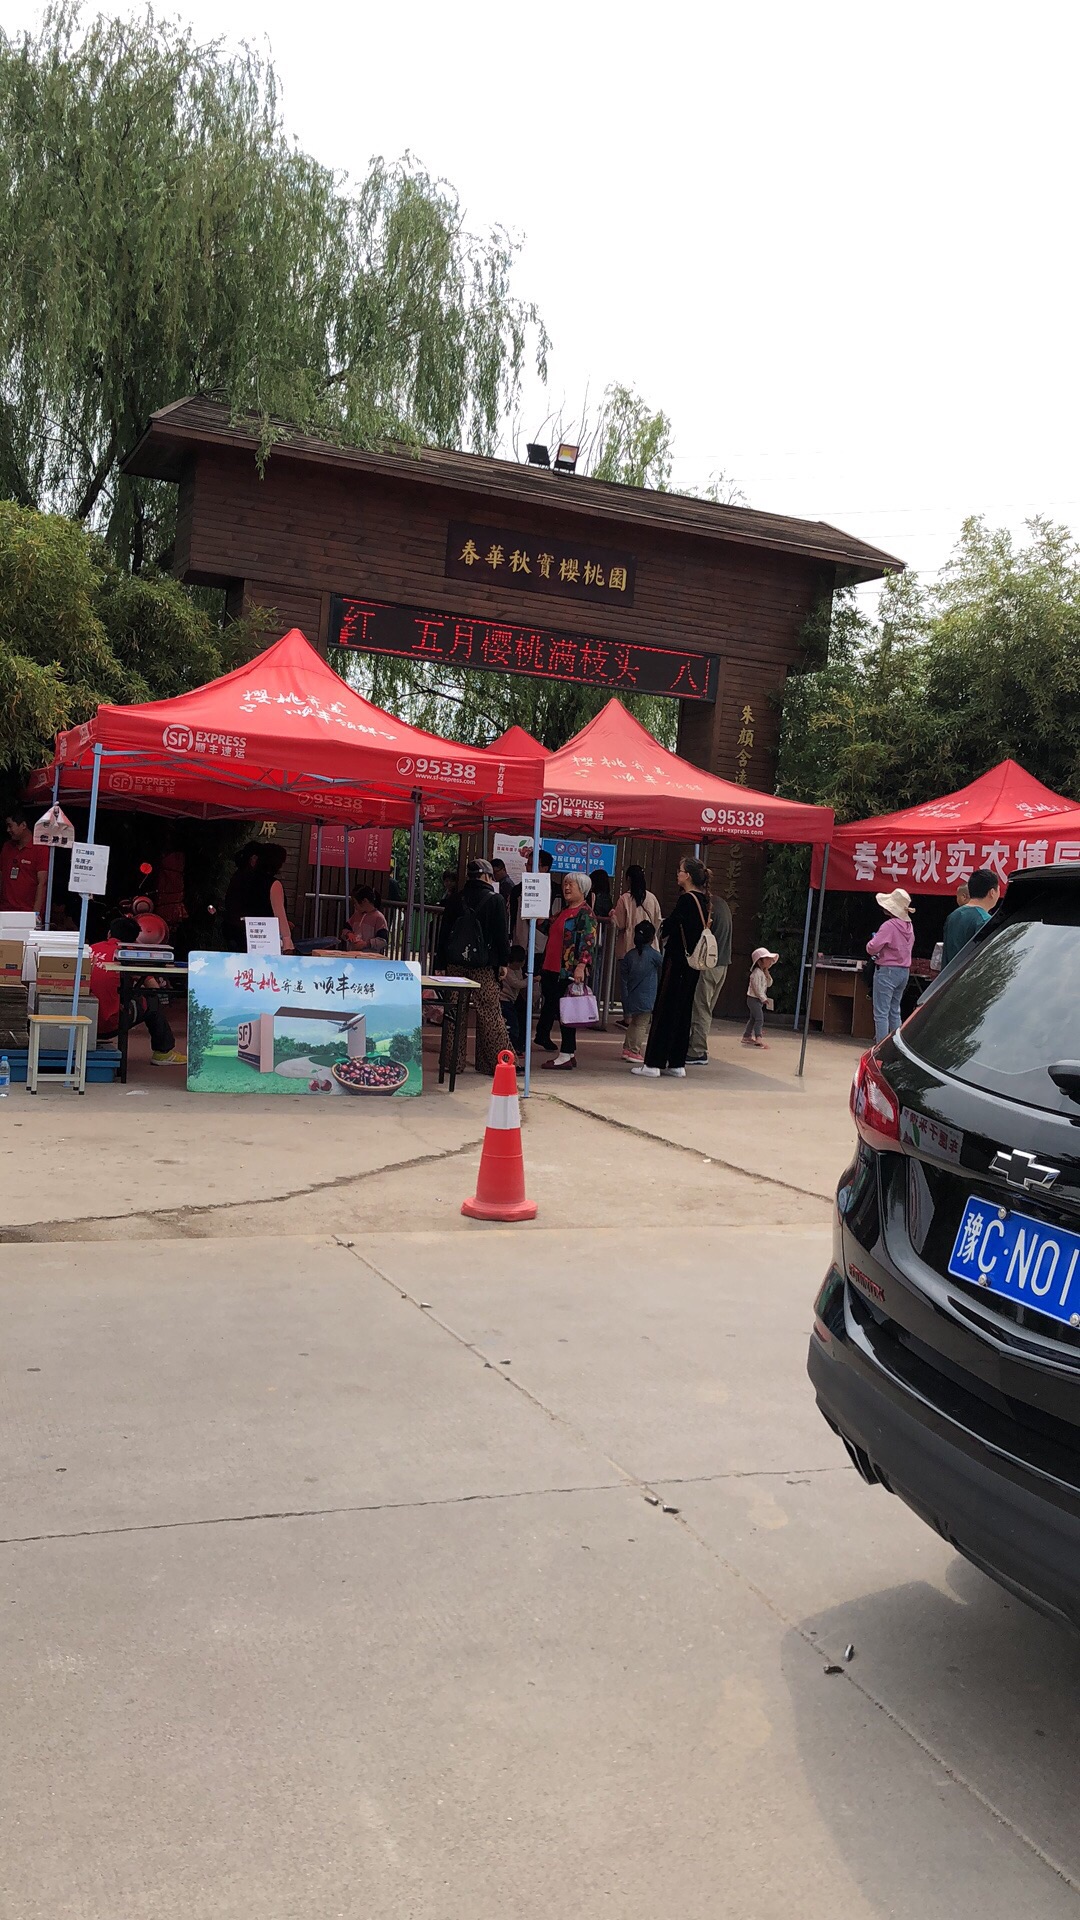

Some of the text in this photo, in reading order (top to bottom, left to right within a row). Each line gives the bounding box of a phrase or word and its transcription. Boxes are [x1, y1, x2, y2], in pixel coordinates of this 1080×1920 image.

[458, 539, 627, 592] 春華秋實櫻桃園
[412, 619, 640, 684] 五月樱桃满枝头
[195, 731, 247, 748] EXPRESS
[194, 742, 245, 759] 顺丰速运
[416, 758, 476, 779] 95338
[135, 776, 176, 787] EXPRESS
[415, 772, 476, 785] www.sf-express.com
[313, 793, 363, 810] 95338
[563, 797, 605, 810] EXPRESS
[563, 808, 605, 820] 顺丰速运
[717, 809, 765, 828] 95338
[700, 826, 764, 836] www.sf-express.com
[313, 972, 376, 1000] 顺丰领鲜
